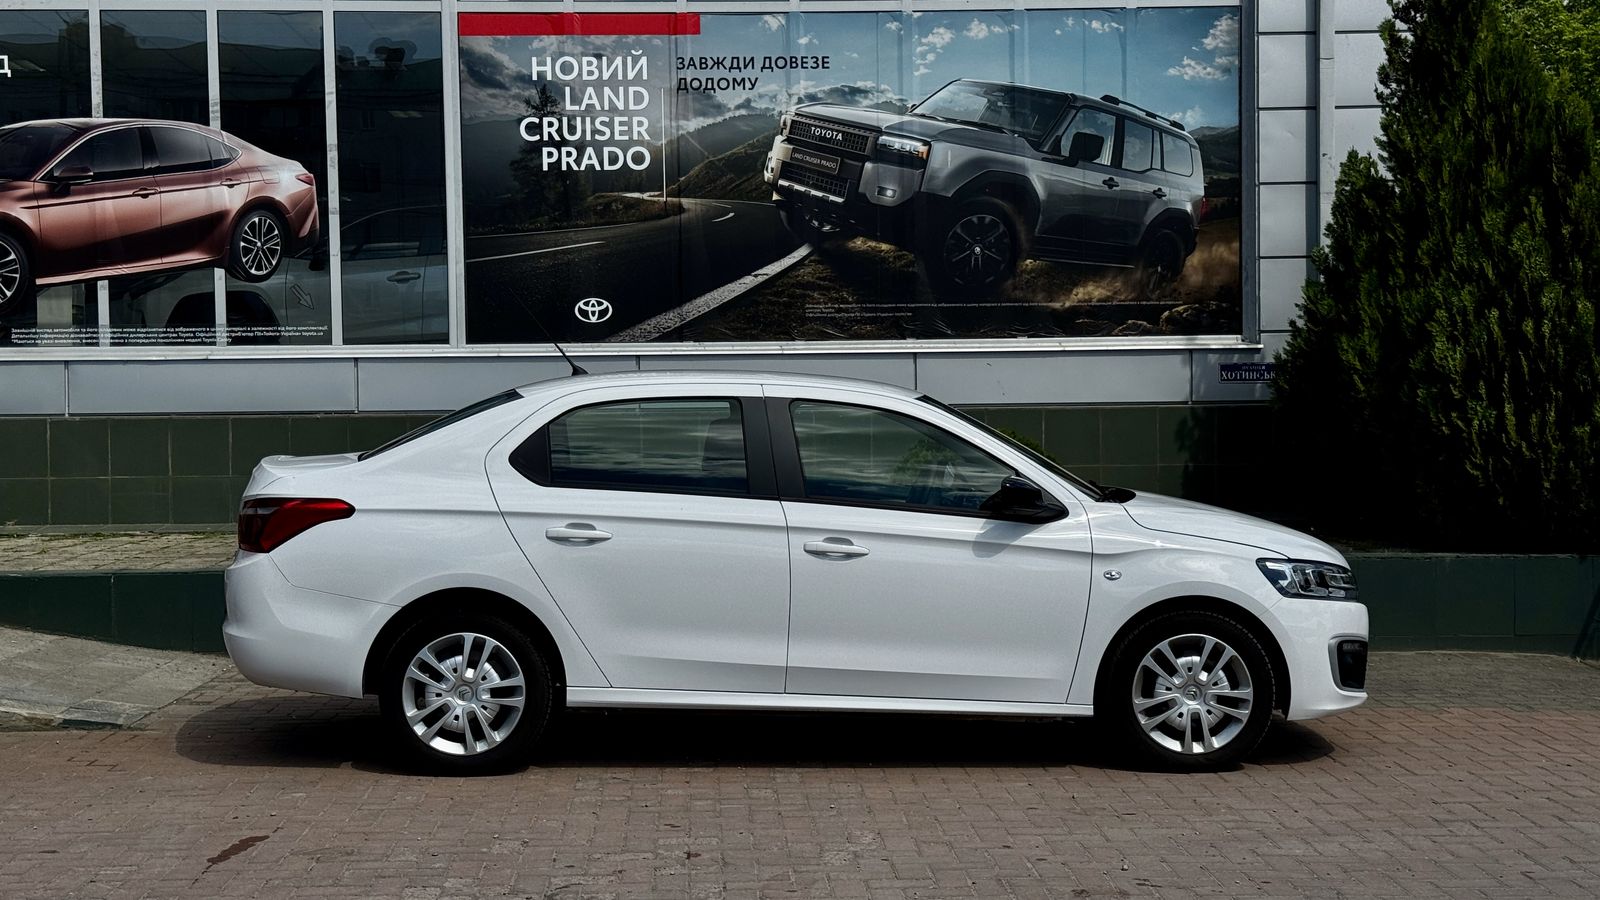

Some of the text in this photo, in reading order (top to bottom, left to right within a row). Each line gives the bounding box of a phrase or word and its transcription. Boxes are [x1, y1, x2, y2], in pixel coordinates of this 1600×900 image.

[532, 49, 648, 81] НОВИЙ
[676, 56, 830, 73] ЗАВЖДИ ДОВЕЗЕ
[677, 77, 759, 94] ДОДОМУ
[565, 86, 650, 111] LAND
[519, 116, 652, 141] CRUISER
[811, 127, 842, 140] TOYOTA
[542, 146, 651, 171] PRADO
[821, 160, 836, 169] PRADO
[1221, 370, 1277, 380] ХОТИНСЬК
